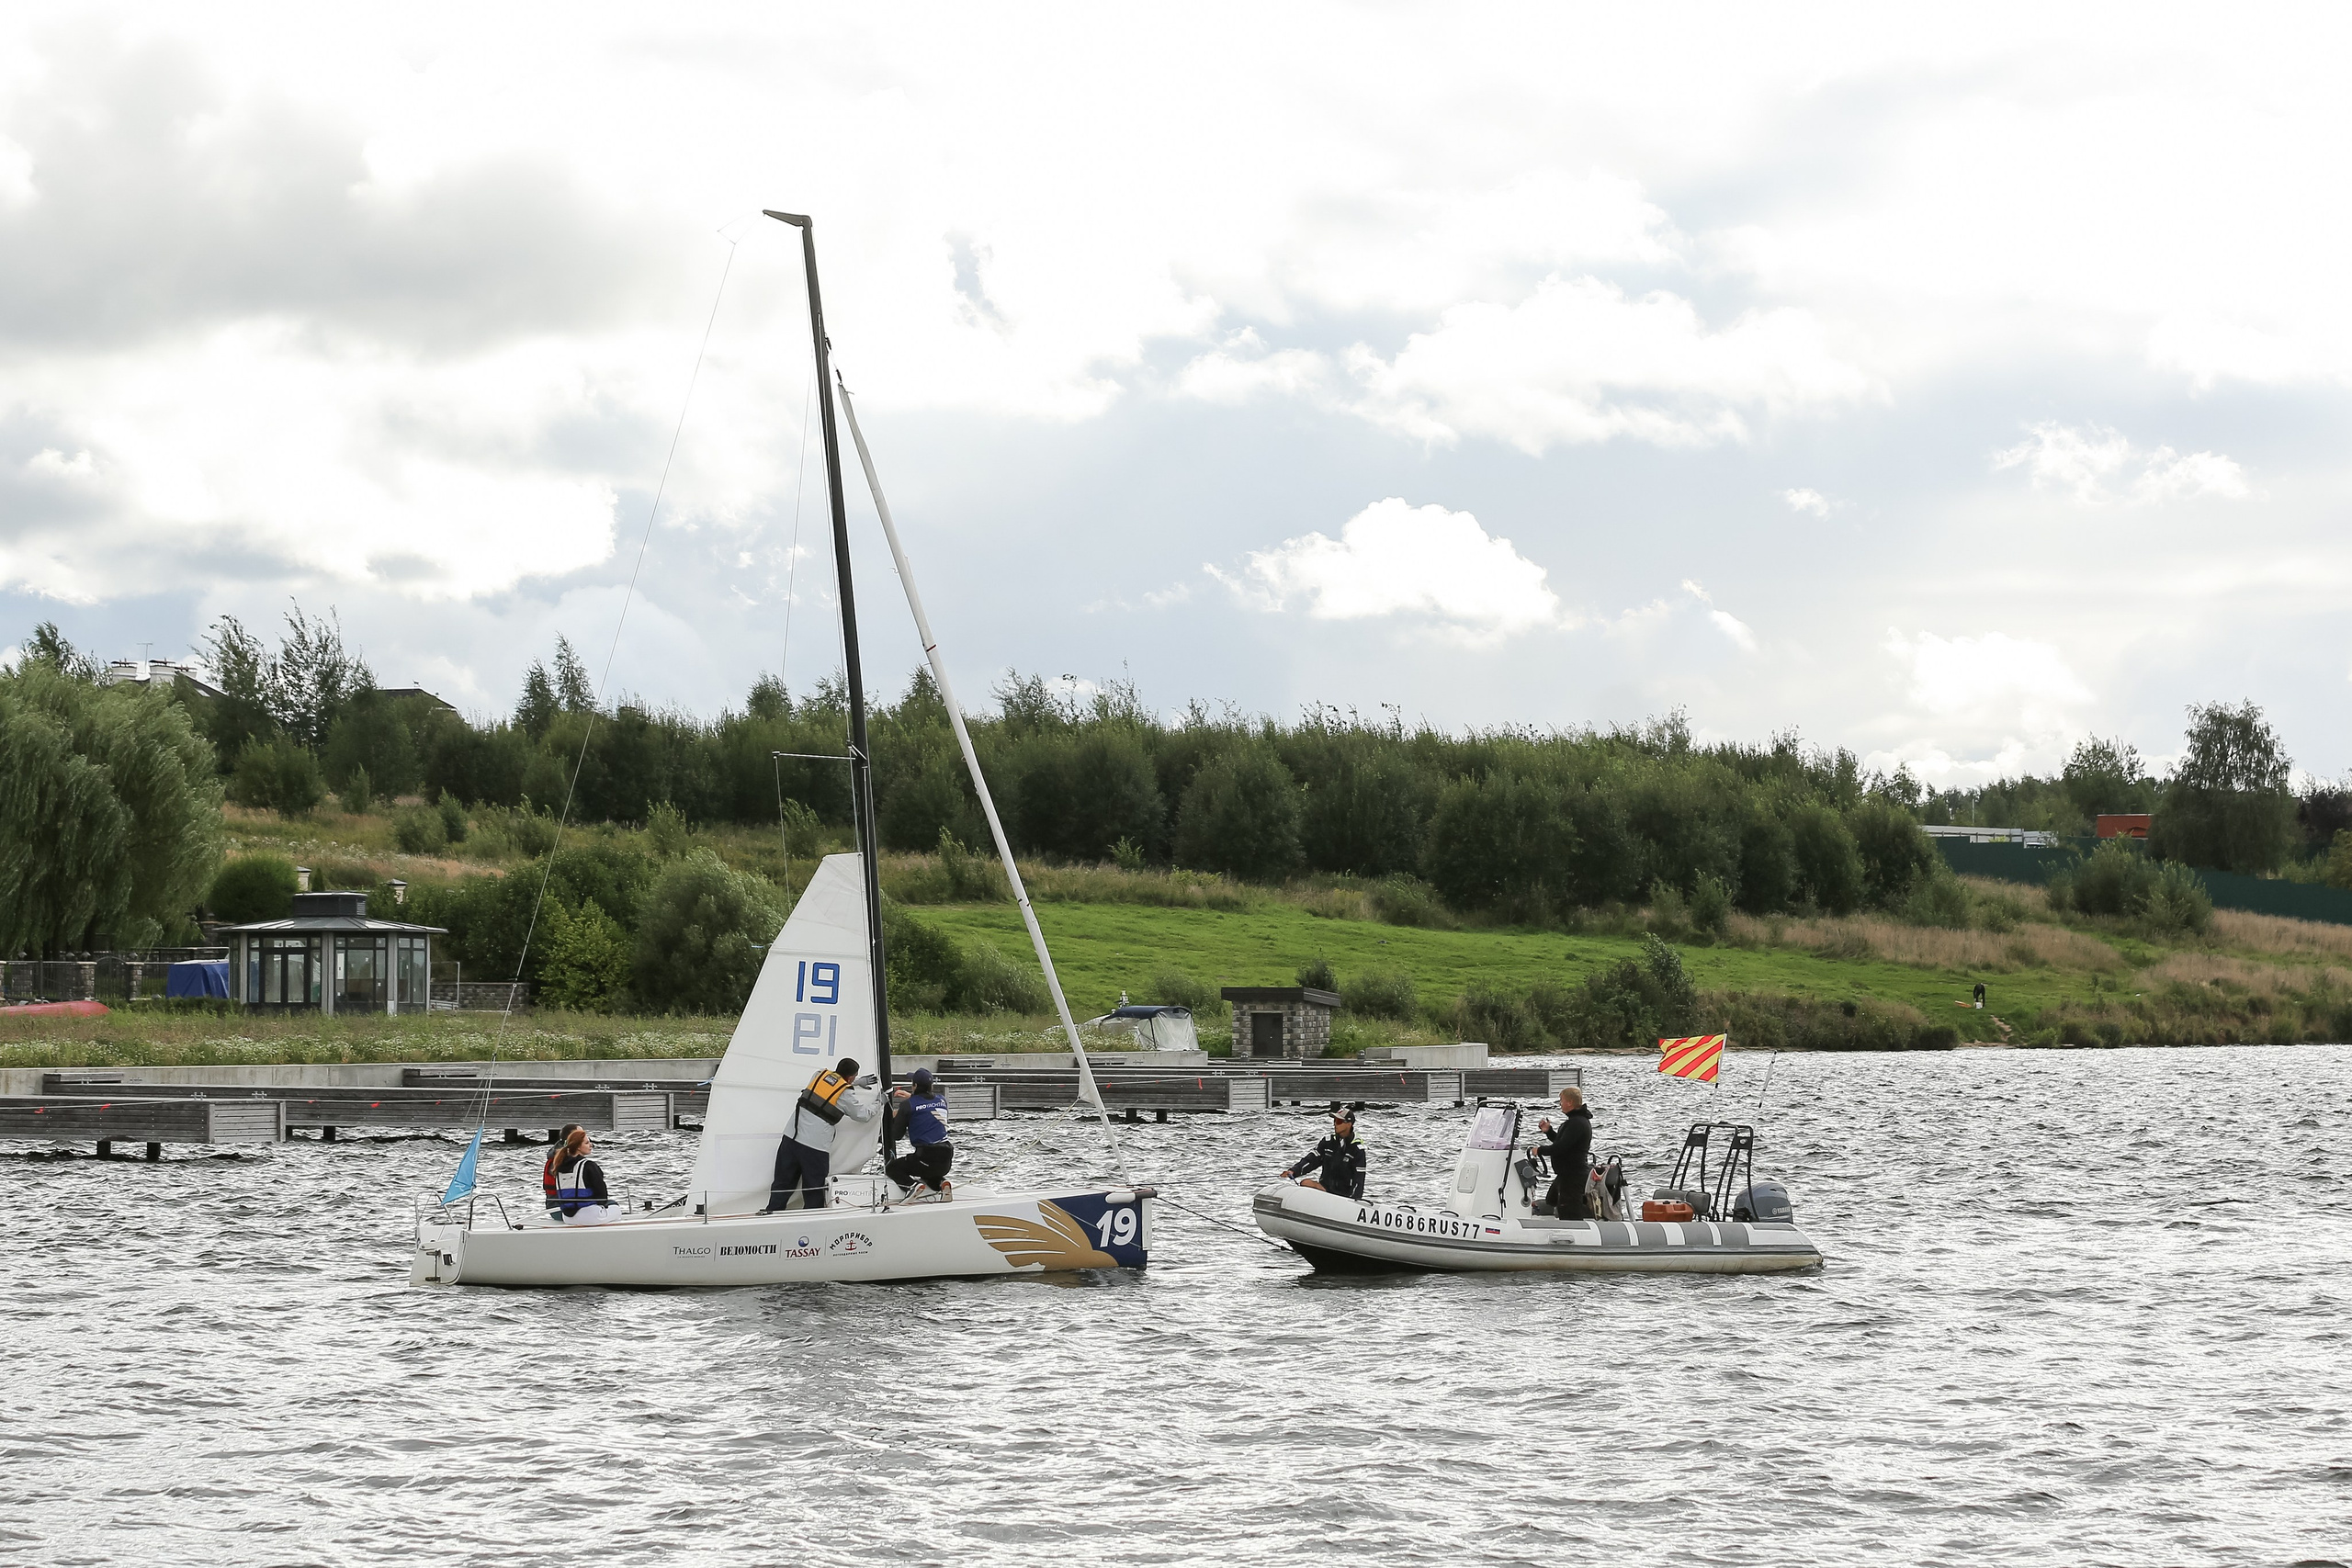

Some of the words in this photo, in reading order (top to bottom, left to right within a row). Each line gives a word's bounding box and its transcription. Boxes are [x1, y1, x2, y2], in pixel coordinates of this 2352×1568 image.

[796, 960, 841, 1005] 19
[1096, 1207, 1137, 1248] 19
[1356, 1208, 1480, 1239] AA0686RUS77
[786, 1247, 821, 1258] TASSAY
[829, 1232, 873, 1250] МОРПРИБОР
